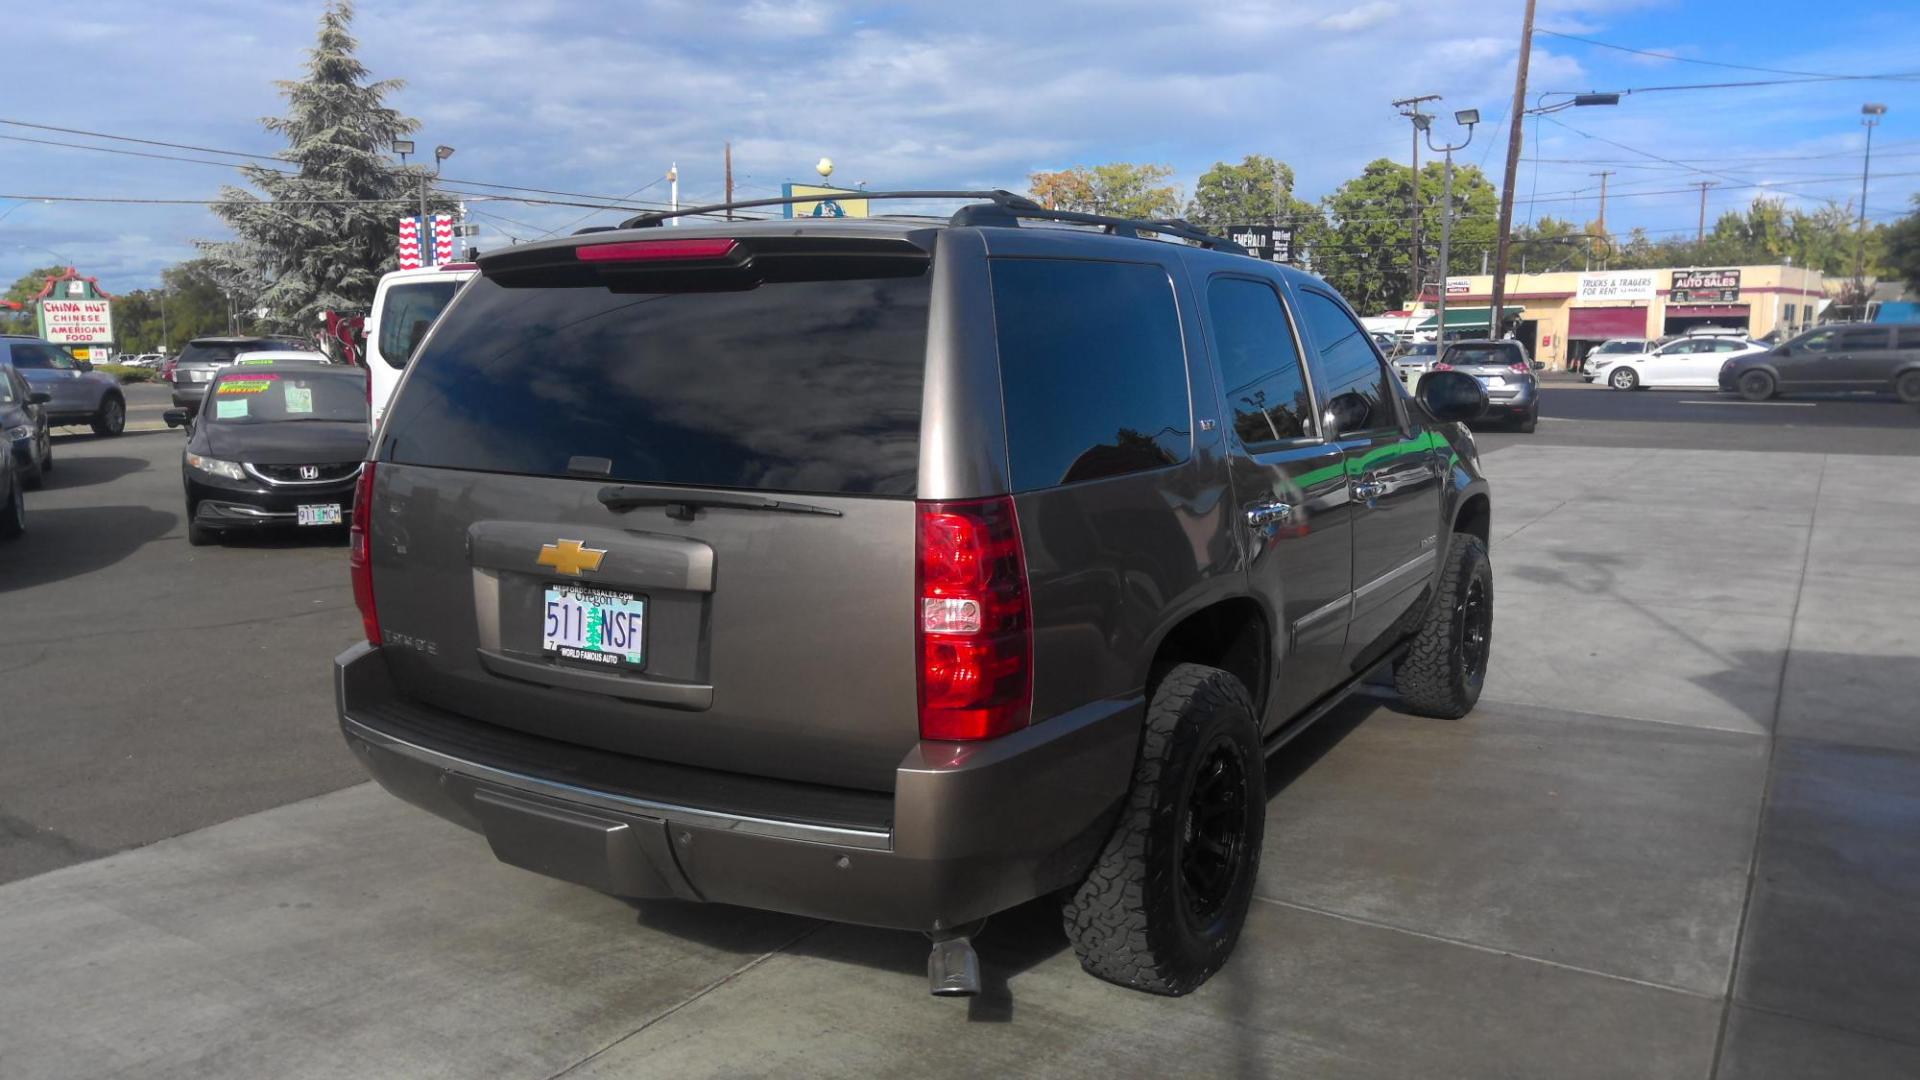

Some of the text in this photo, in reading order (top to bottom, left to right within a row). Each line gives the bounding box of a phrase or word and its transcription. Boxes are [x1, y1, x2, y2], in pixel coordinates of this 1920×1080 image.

[1233, 233, 1266, 248] EMERALD
[1583, 278, 1652, 287] TRUCKS & TRAILERS
[1675, 277, 1736, 288] AUTO SALES
[1583, 287, 1598, 296] FOR
[1600, 287, 1617, 295] RENT
[44, 302, 107, 313] CHINA HUT
[53, 314, 100, 322] CHINESE
[51, 326, 106, 334] AMERICAN
[547, 601, 641, 649] 511 NSF
[561, 647, 618, 664] WORLD FAMOUS AUTO
